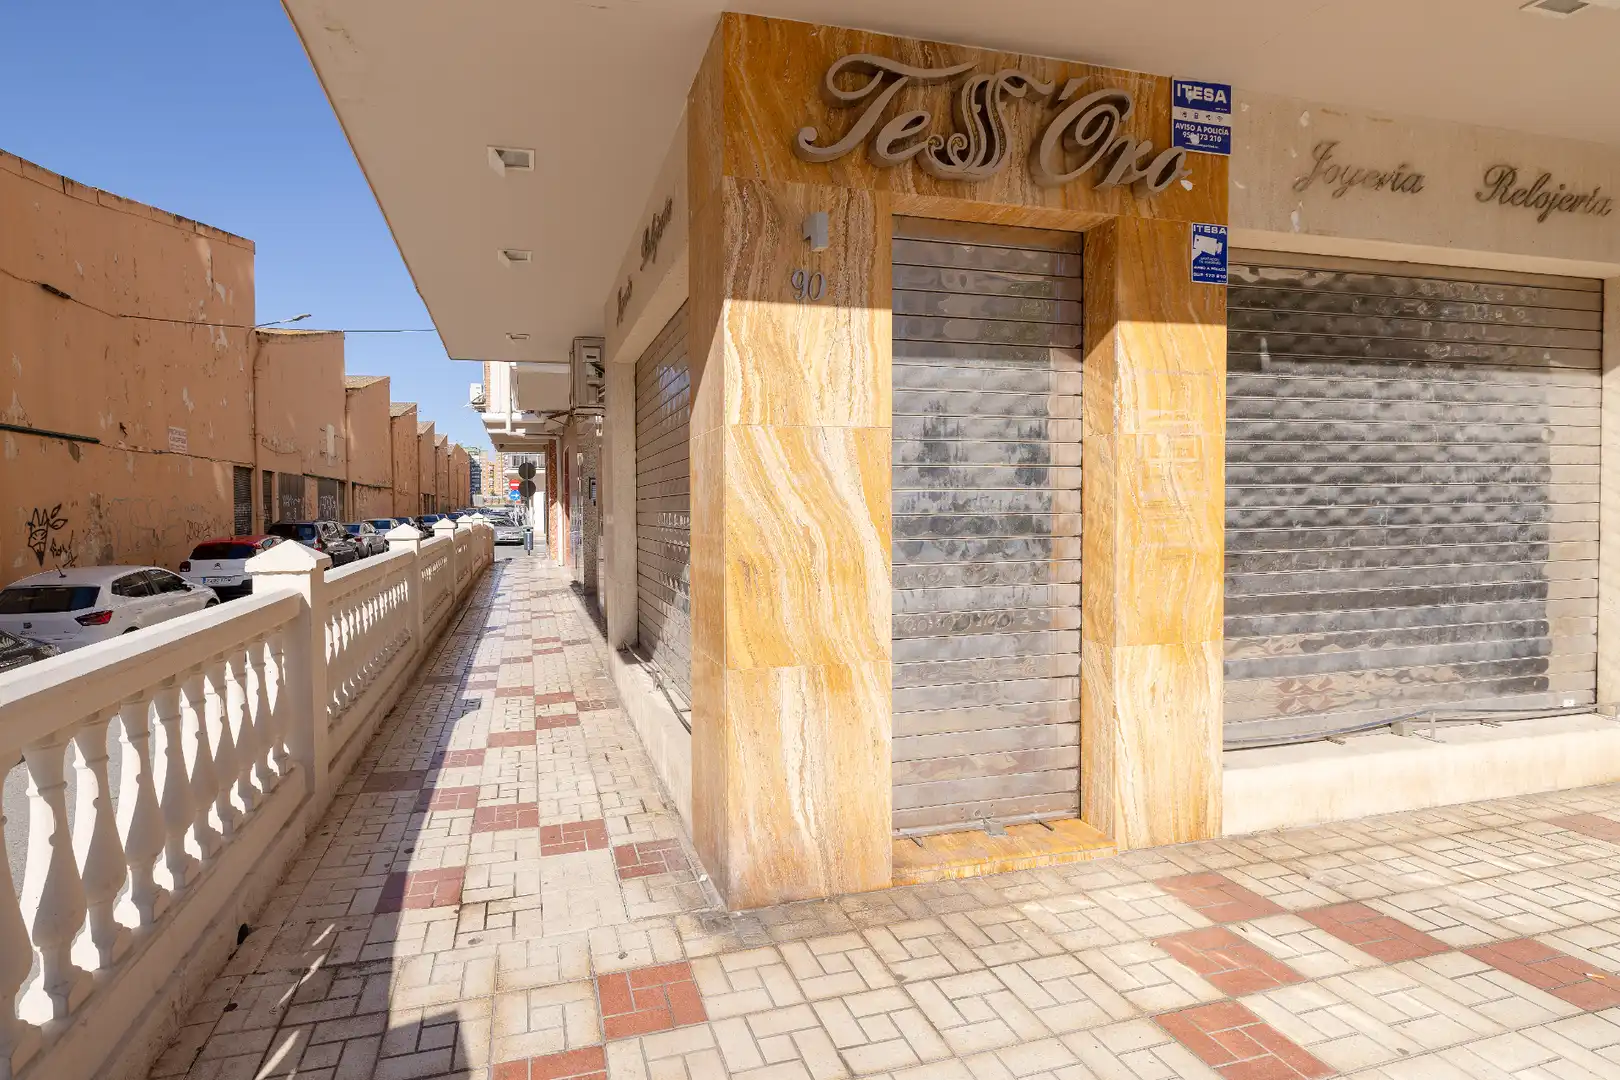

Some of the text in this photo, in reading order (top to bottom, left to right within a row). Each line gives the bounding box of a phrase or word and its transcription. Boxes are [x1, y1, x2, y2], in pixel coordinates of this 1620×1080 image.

[1176, 83, 1227, 104] ITESA
[1175, 122, 1195, 130] AVISO
[1204, 126, 1229, 135] POLICÍA
[1210, 135, 1222, 143] 210
[1293, 140, 1613, 223] Joyería Relojería
[1193, 225, 1226, 235] ITESA
[791, 268, 826, 301] 90
